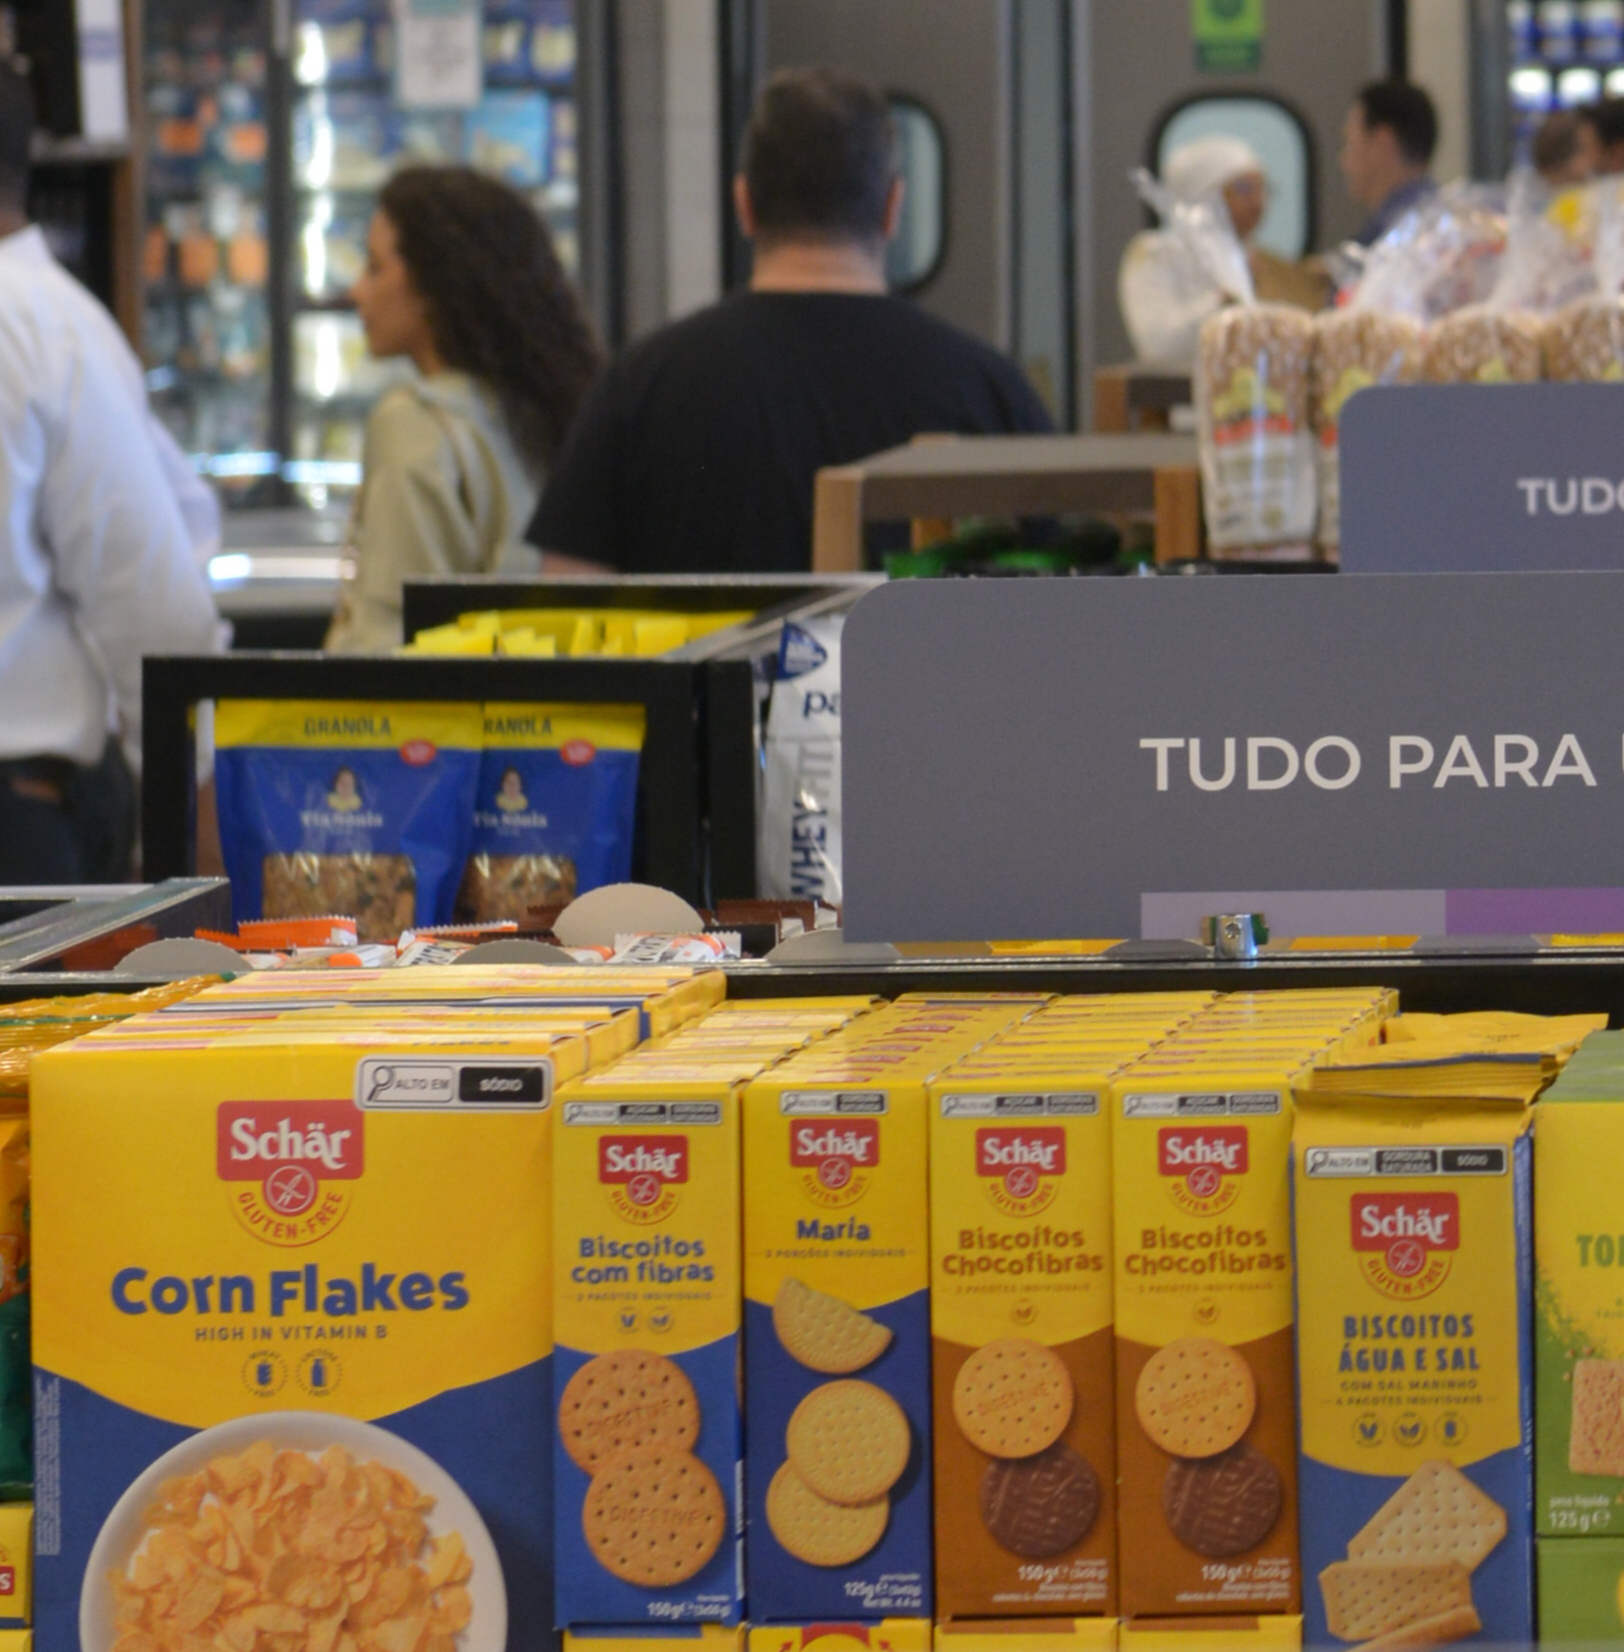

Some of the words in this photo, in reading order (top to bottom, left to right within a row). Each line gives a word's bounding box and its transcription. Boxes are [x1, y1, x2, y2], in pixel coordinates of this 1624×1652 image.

[304, 716, 391, 736] GRANOLA
[484, 716, 552, 736] RANOLA
[1139, 735, 1361, 792] TUDO
[1389, 734, 1597, 789] PARA
[229, 1116, 352, 1170] Schär
[796, 1127, 873, 1162] Schär
[982, 1136, 1060, 1171] Schär
[1165, 1135, 1242, 1170] Schär
[605, 1144, 683, 1178] Schär
[237, 1190, 344, 1240] GLUTEN-FREE
[1359, 1203, 1450, 1245] Schär
[579, 1234, 706, 1259] Biscoitos
[958, 1226, 1085, 1251] Biscoitos
[1141, 1225, 1268, 1250] Biscoitos
[571, 1264, 629, 1285] com
[637, 1260, 716, 1284] fibras
[943, 1251, 1104, 1277] Chocofibras
[1125, 1250, 1287, 1276] Chocofibras
[110, 1265, 256, 1316] Corn
[270, 1261, 471, 1317] Flakes
[195, 1326, 244, 1342] HIGH
[252, 1326, 273, 1341] IN
[280, 1325, 368, 1340] VITAMIN
[376, 1324, 388, 1340] B
[1343, 1313, 1475, 1340] BISCOITOS
[1338, 1341, 1406, 1373] ÁGUA
[1415, 1347, 1429, 1372] E
[1436, 1346, 1481, 1371] SAL
[1550, 1510, 1578, 1529] 125
